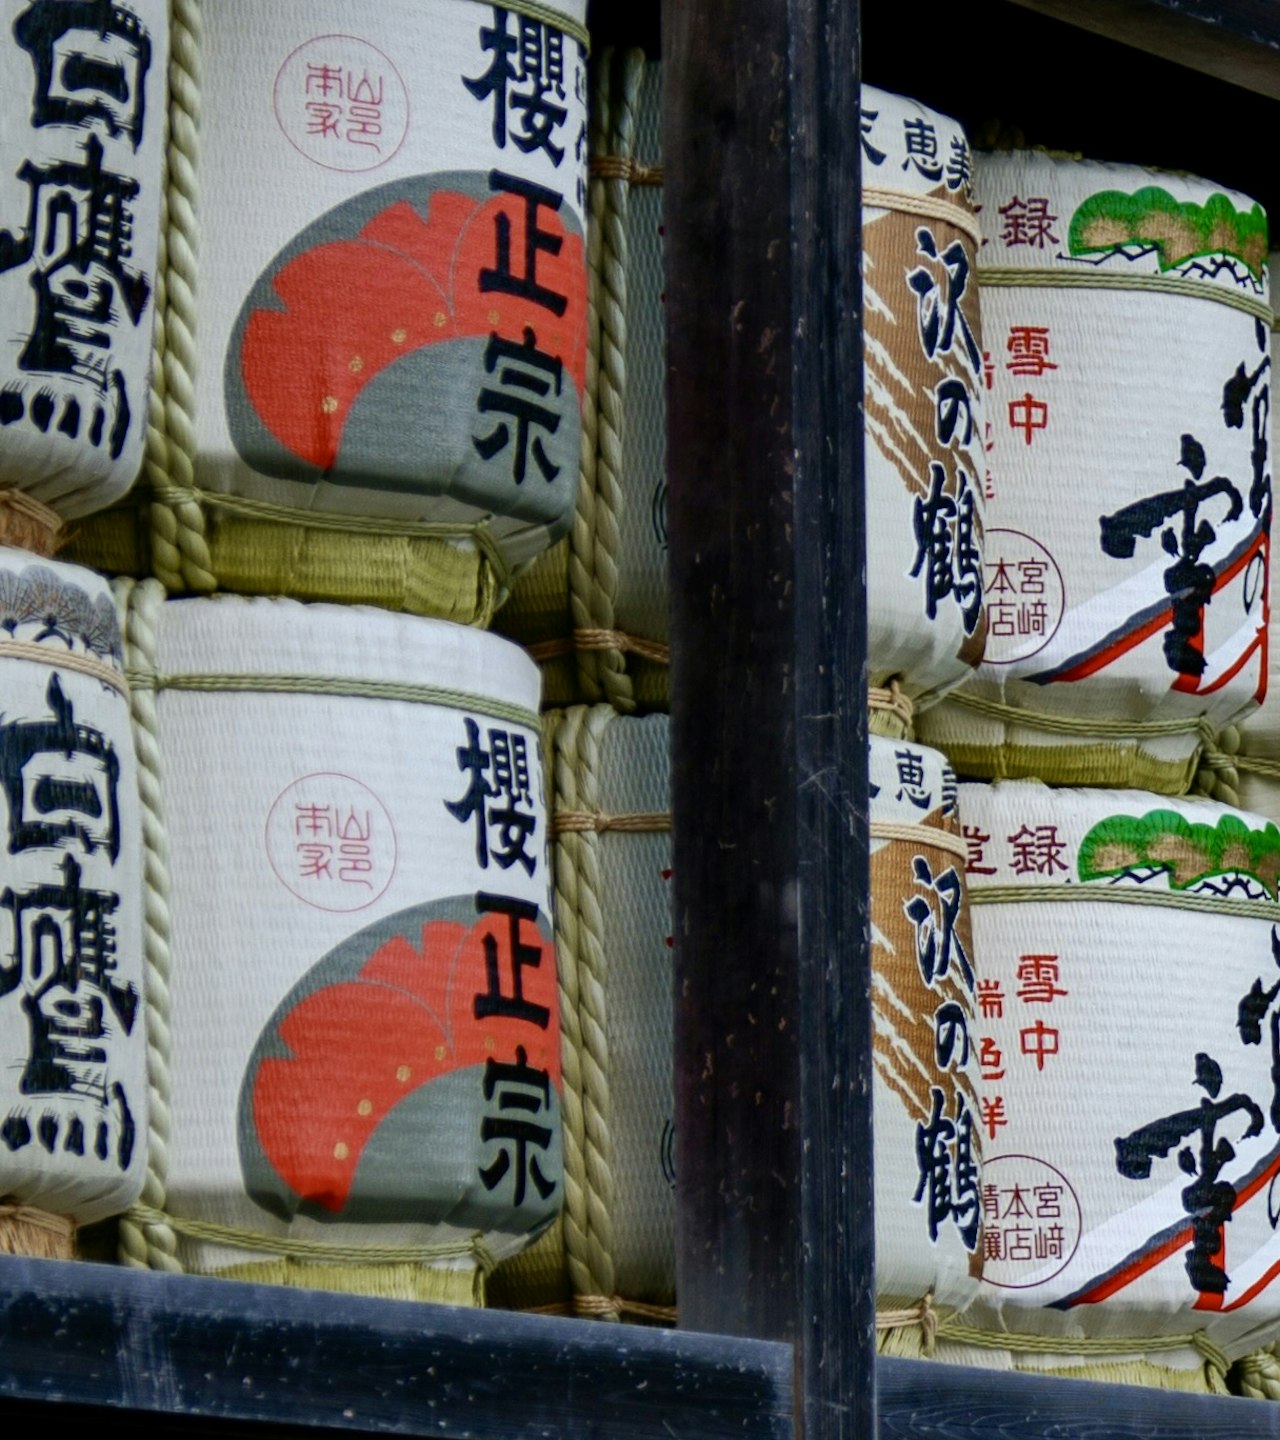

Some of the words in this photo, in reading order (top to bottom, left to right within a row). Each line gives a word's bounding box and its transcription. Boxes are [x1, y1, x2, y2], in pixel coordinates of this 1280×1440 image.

[461, 8, 569, 485] 櫻正宗
[904, 226, 985, 638] 沢の鶴
[1004, 326, 1058, 444] 雪中
[444, 717, 557, 1207] 櫻正宗
[904, 855, 981, 1252] 沢の鶴
[1016, 954, 1068, 1071] 雪中
